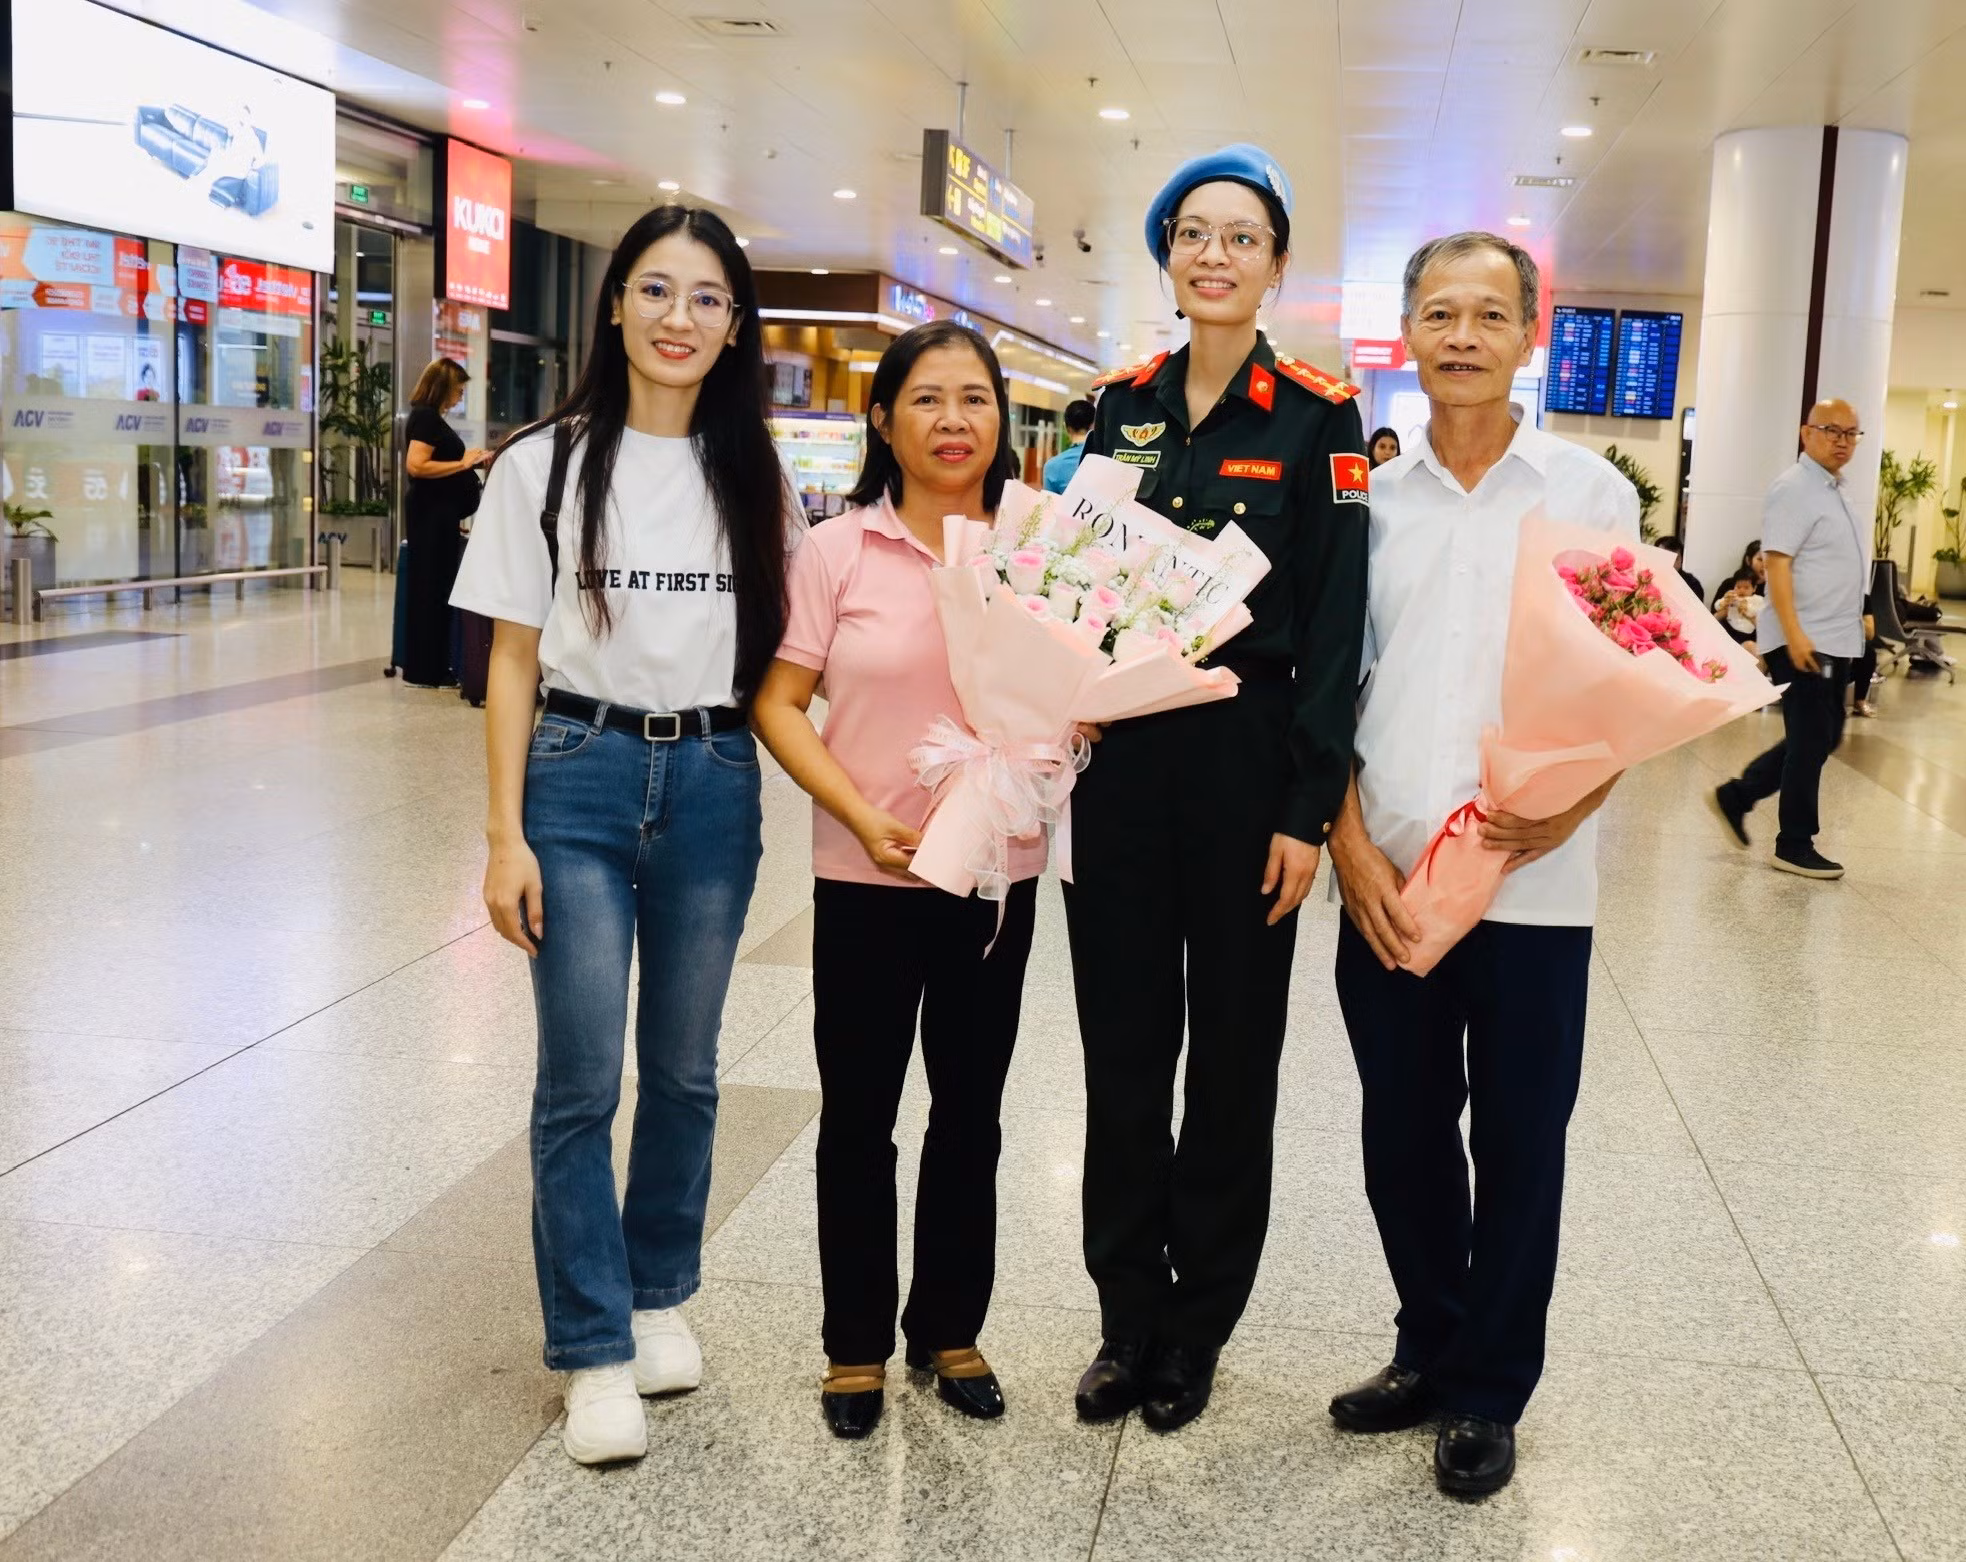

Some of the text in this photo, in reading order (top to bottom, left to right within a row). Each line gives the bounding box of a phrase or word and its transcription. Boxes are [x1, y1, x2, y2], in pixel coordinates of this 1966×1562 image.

[13, 409, 45, 428] ACV
[115, 414, 142, 431] ACV
[1251, 465, 1276, 477] NAM
[628, 570, 650, 590] AT
[656, 572, 710, 592] FIRST
